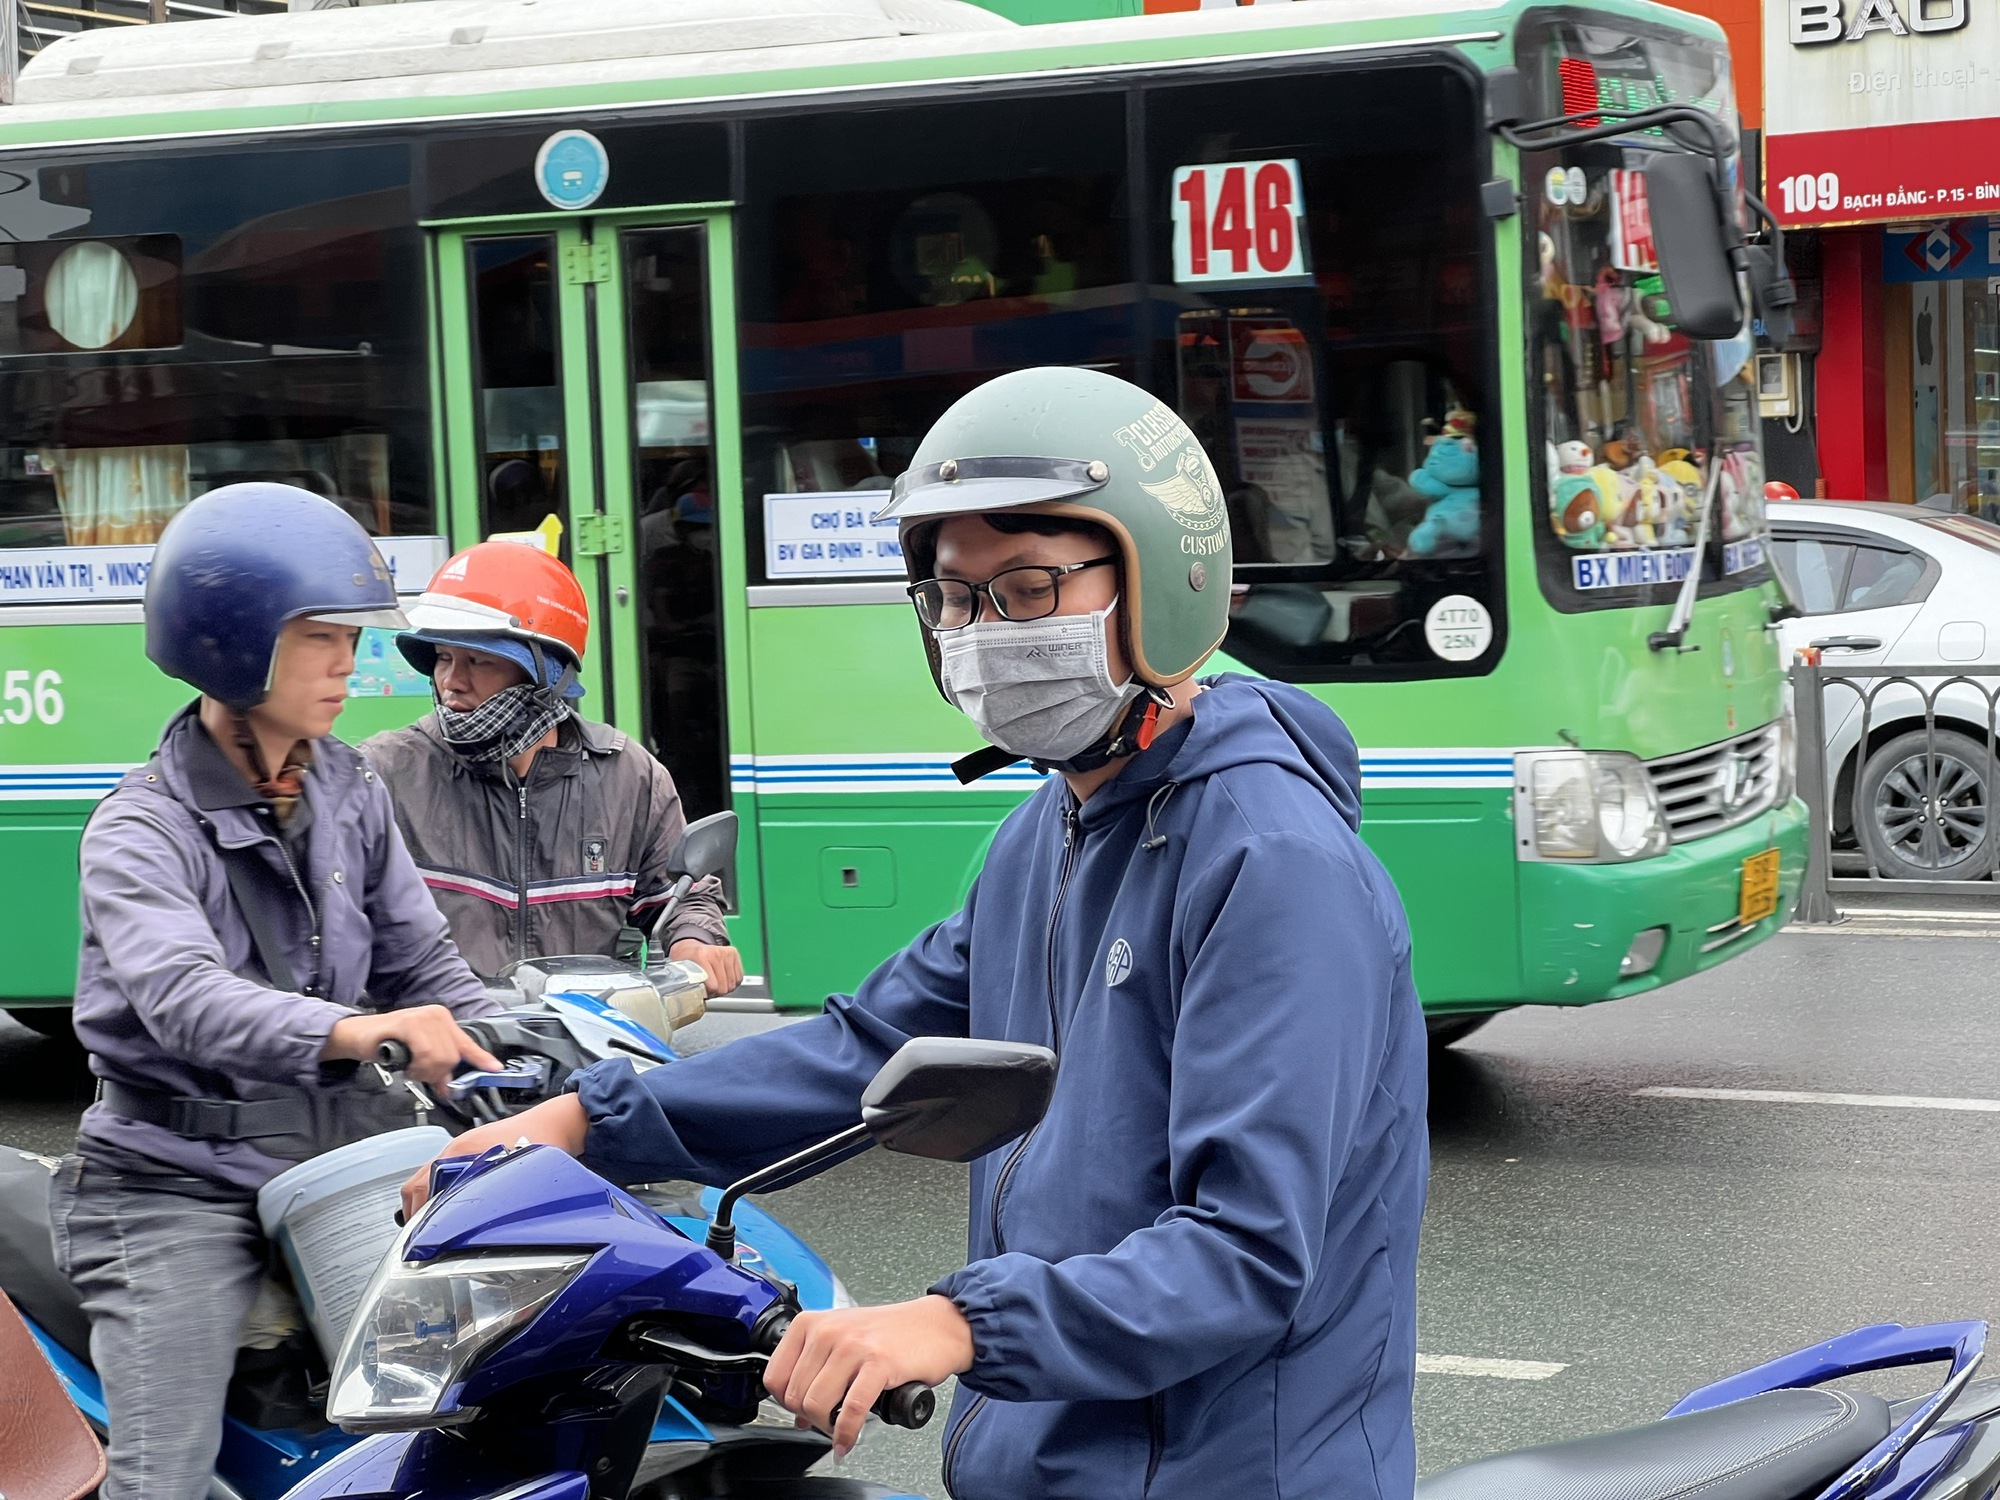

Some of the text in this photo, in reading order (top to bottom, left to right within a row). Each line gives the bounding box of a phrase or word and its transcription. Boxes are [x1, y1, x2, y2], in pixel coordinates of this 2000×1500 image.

[1778, 172, 1840, 214] 109
[1843, 193, 1883, 212] BẠCH
[1937, 188, 1966, 203] P.15
[1179, 162, 1293, 275] 146
[801, 543, 825, 560] GIA
[1180, 529, 1226, 556] CUSTOM
[35, 560, 66, 589] VĂN
[69, 563, 94, 593] TRỊ
[1577, 558, 1610, 588] BX
